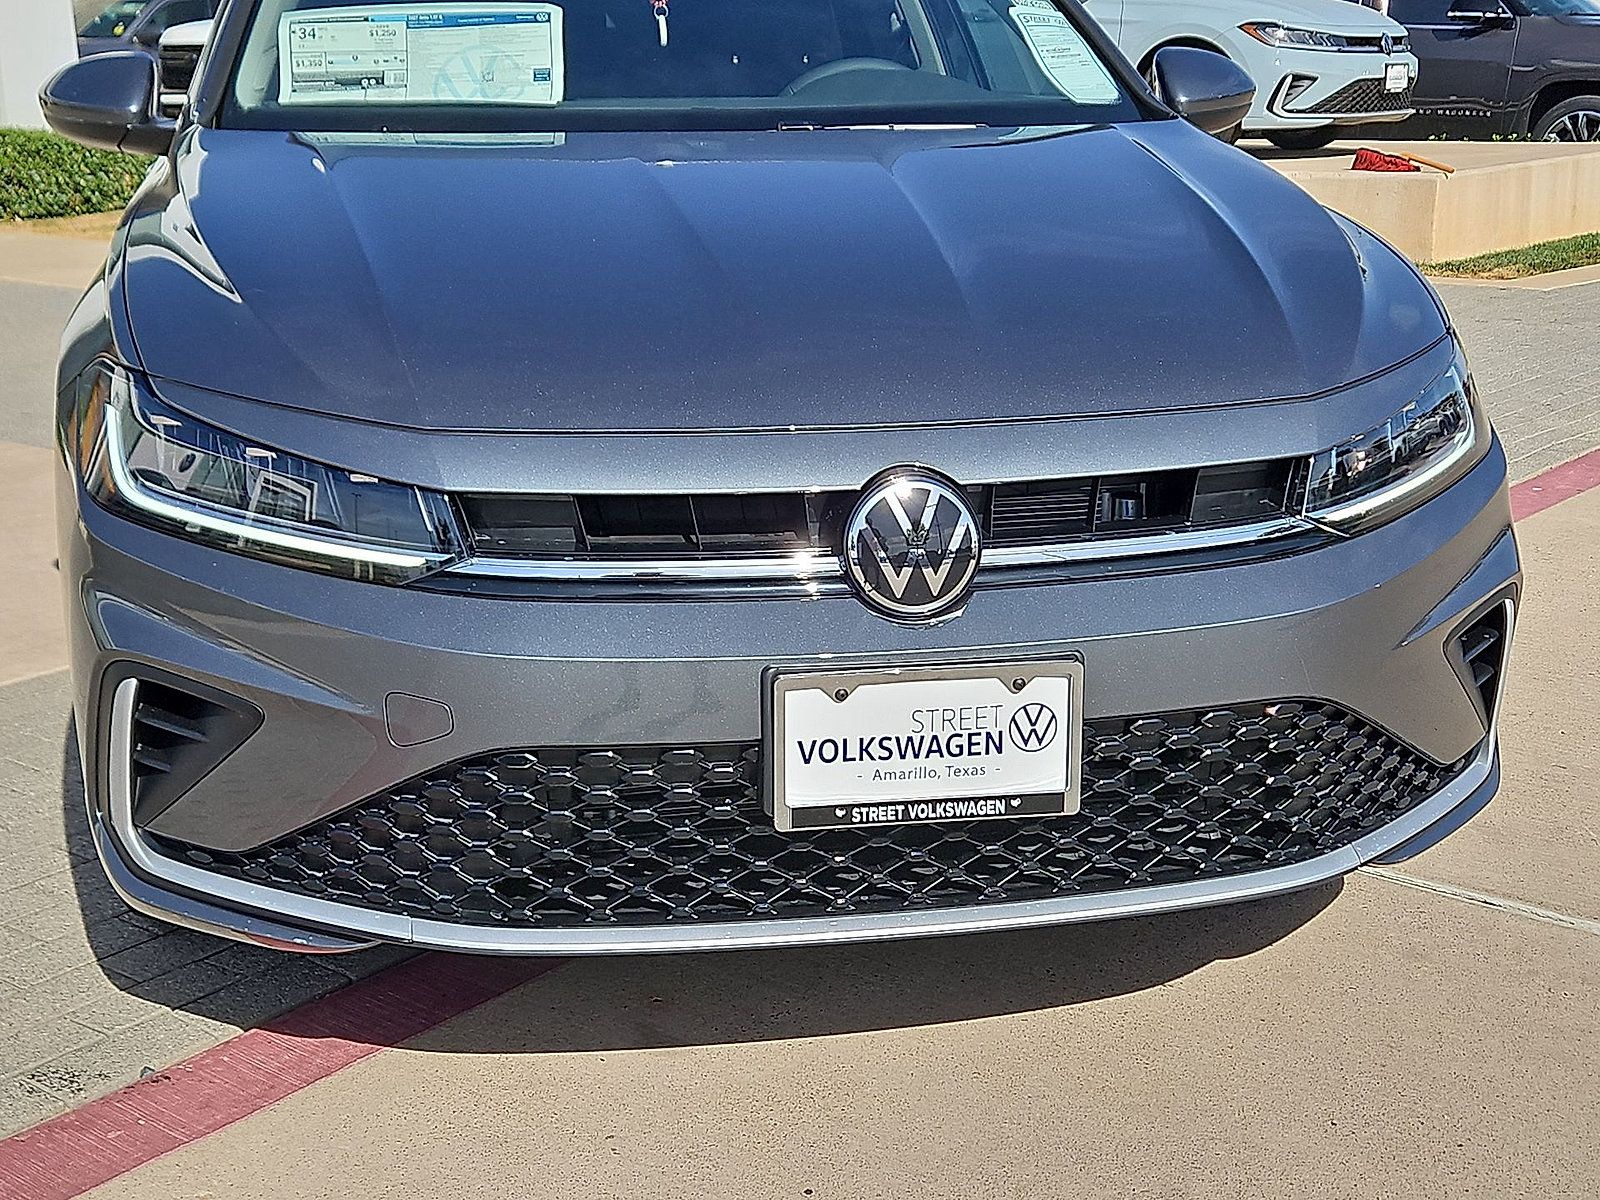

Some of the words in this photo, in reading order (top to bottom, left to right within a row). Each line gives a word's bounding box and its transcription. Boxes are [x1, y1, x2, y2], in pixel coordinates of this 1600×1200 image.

[297, 27, 317, 40] 34
[911, 704, 1004, 734] STREET
[797, 730, 1003, 765] VOLKSWAGEN
[872, 766, 941, 781] Amarillo,
[946, 765, 986, 779] Texas
[851, 806, 904, 823] STREET
[908, 799, 1006, 819] VOLKSWAGEN
